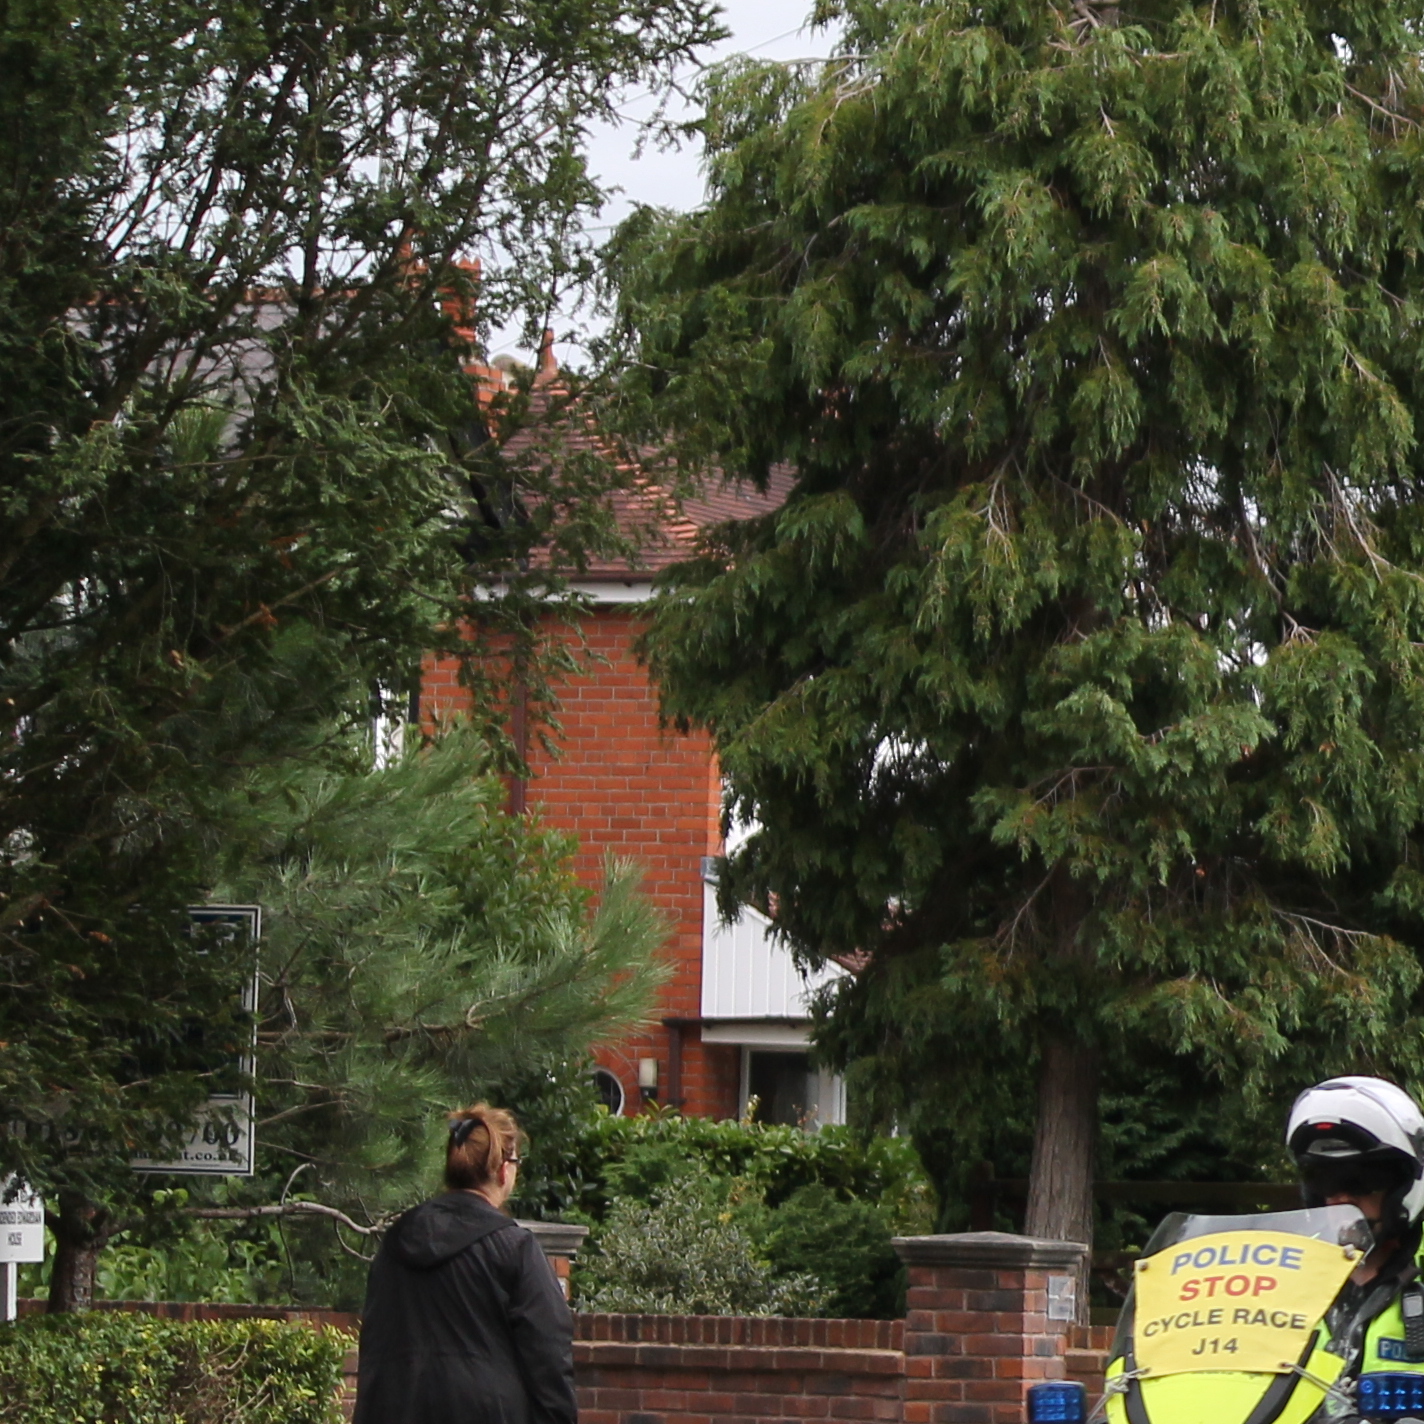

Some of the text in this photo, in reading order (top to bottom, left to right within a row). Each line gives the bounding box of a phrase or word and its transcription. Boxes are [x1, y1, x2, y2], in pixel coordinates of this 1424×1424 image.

[1170, 1244, 1304, 1275] POLICE
[1179, 1274, 1277, 1301] STOP
[1143, 1308, 1307, 1338] CYCLE RACE
[1192, 1337, 1239, 1355] J14
